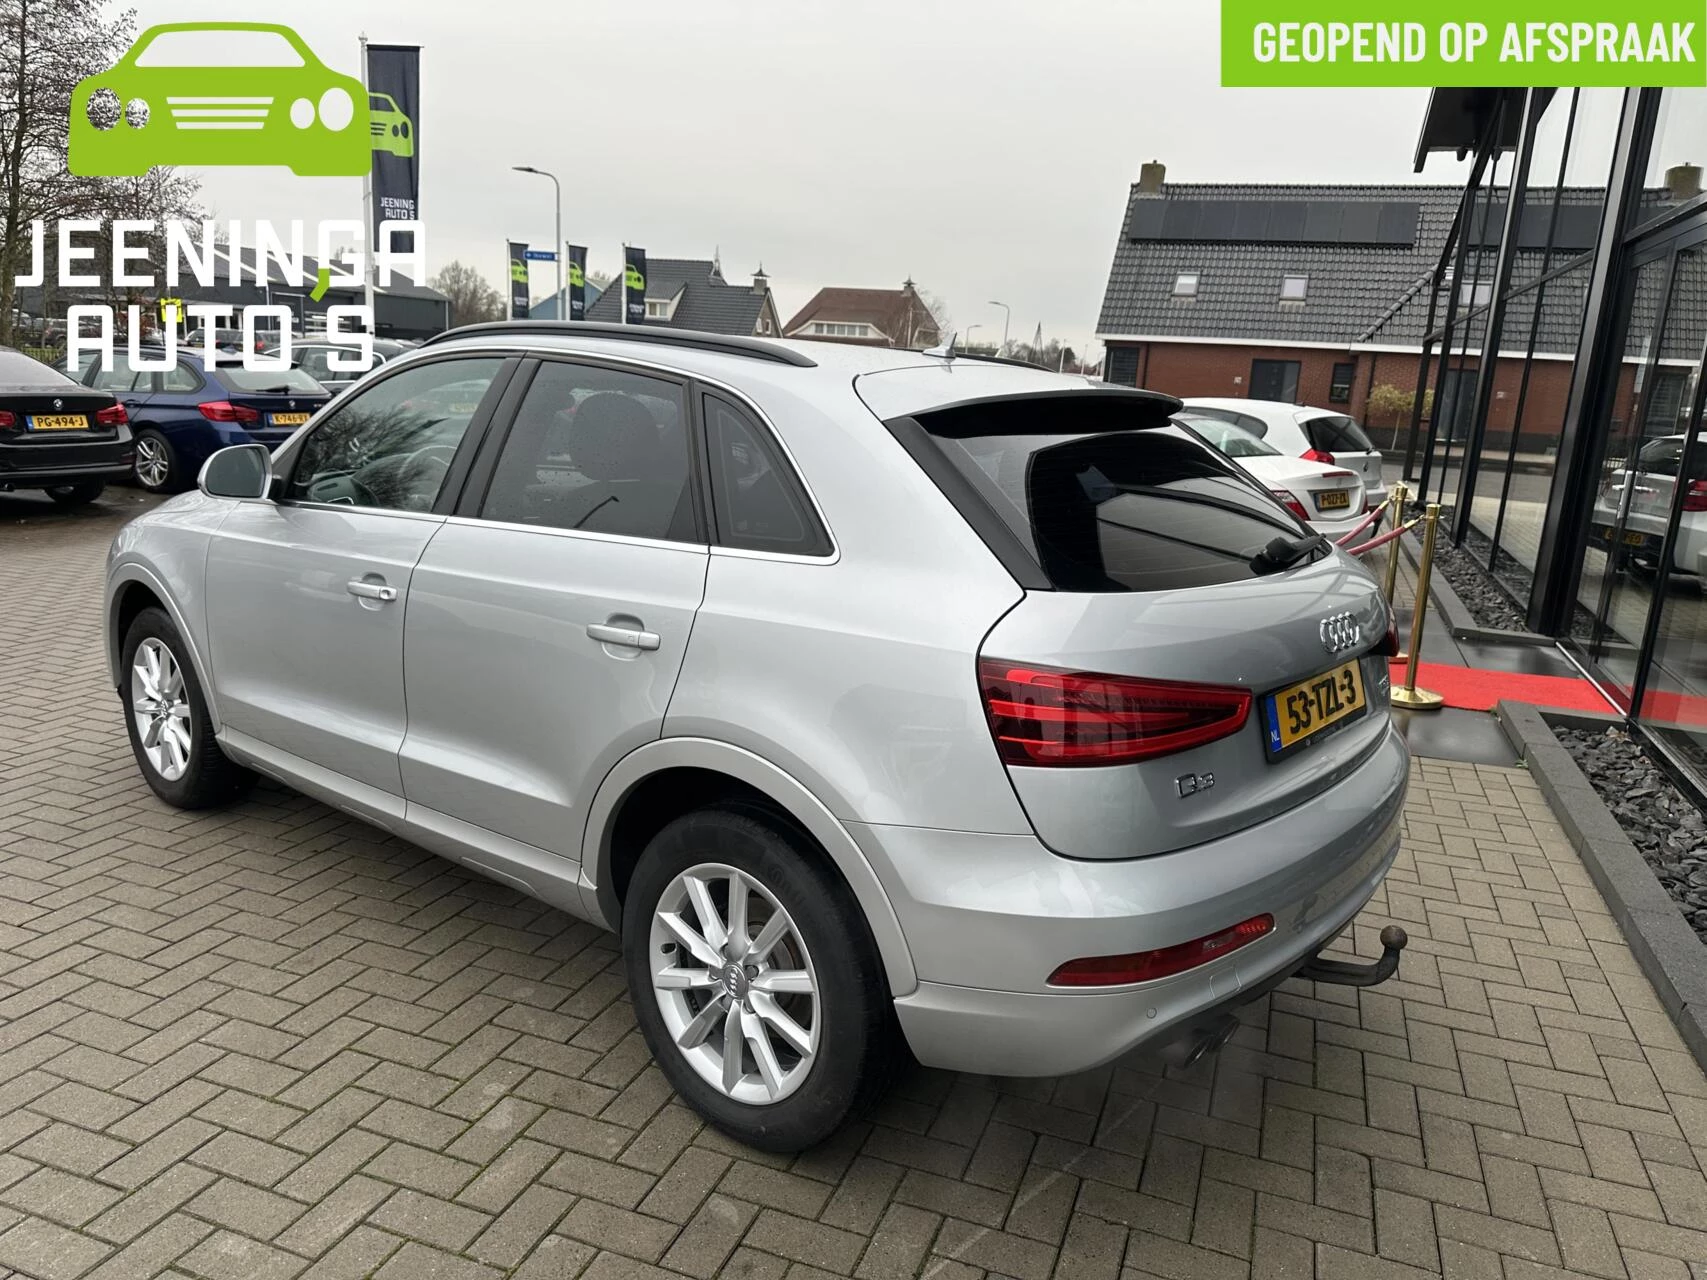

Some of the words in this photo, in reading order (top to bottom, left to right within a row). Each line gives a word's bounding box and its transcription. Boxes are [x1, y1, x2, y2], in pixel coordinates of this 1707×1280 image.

[36, 416, 84, 427] PG-494-J
[1286, 669, 1357, 735] 53-TZL-3
[1270, 728, 1280, 743] NL
